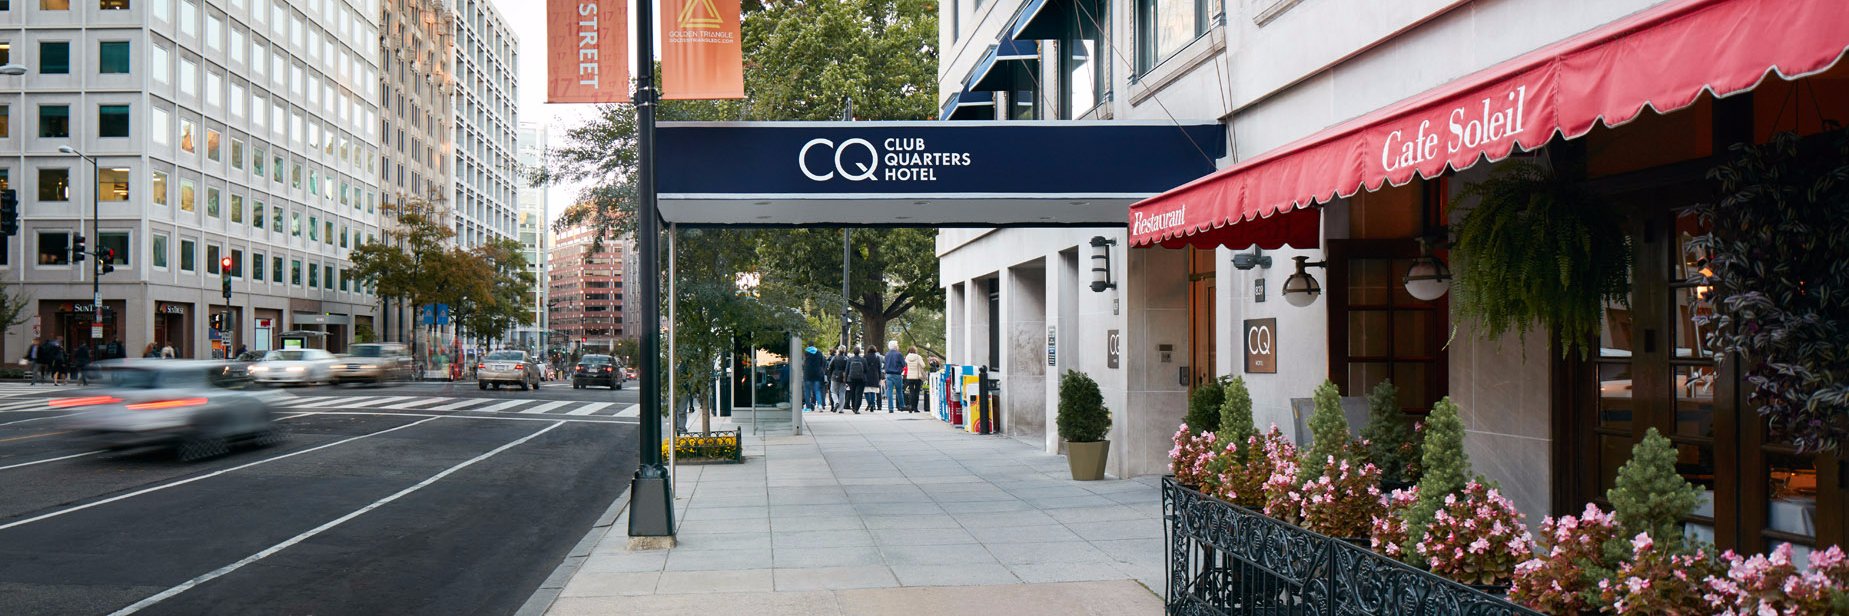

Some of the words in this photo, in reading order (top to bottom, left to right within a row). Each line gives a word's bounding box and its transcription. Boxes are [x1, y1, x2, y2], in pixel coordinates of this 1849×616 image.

[579, 3, 599, 89] STREET
[700, 30, 733, 39] TRIANGLE
[1382, 119, 1438, 172] Cafe
[1448, 85, 1526, 154] Soleil
[799, 138, 878, 181] CQ
[884, 138, 925, 151] CLUB
[884, 153, 971, 166] QUARTERS
[885, 168, 937, 181] HOTEL
[1133, 204, 1185, 236] Restaurant
[1249, 325, 1270, 355] CQ
